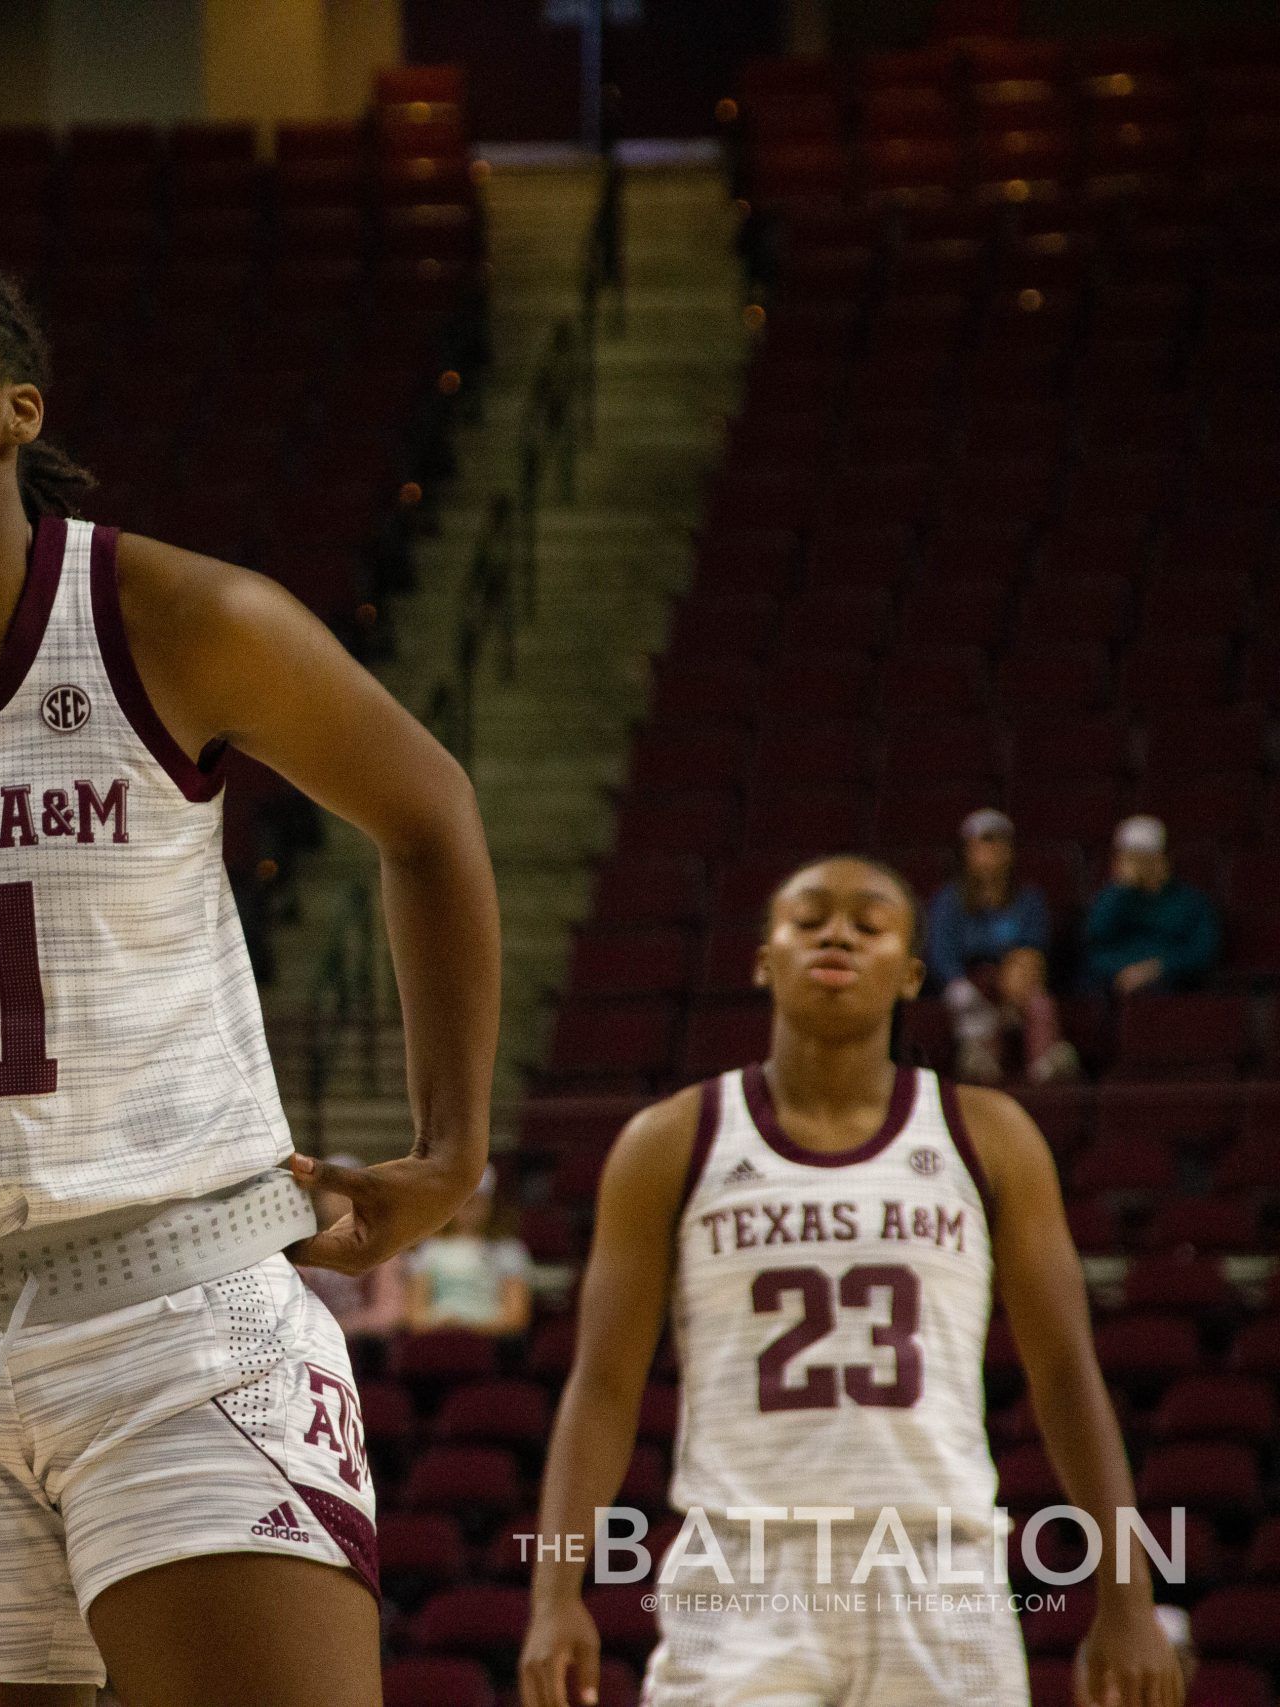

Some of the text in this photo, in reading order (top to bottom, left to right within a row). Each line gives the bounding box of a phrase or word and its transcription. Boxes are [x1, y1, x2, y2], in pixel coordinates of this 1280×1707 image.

[45, 689, 88, 730] SEC
[700, 1200, 967, 1255] TEXAS A&M
[751, 1263, 922, 1413] 23
[250, 1523, 310, 1544] adidas
